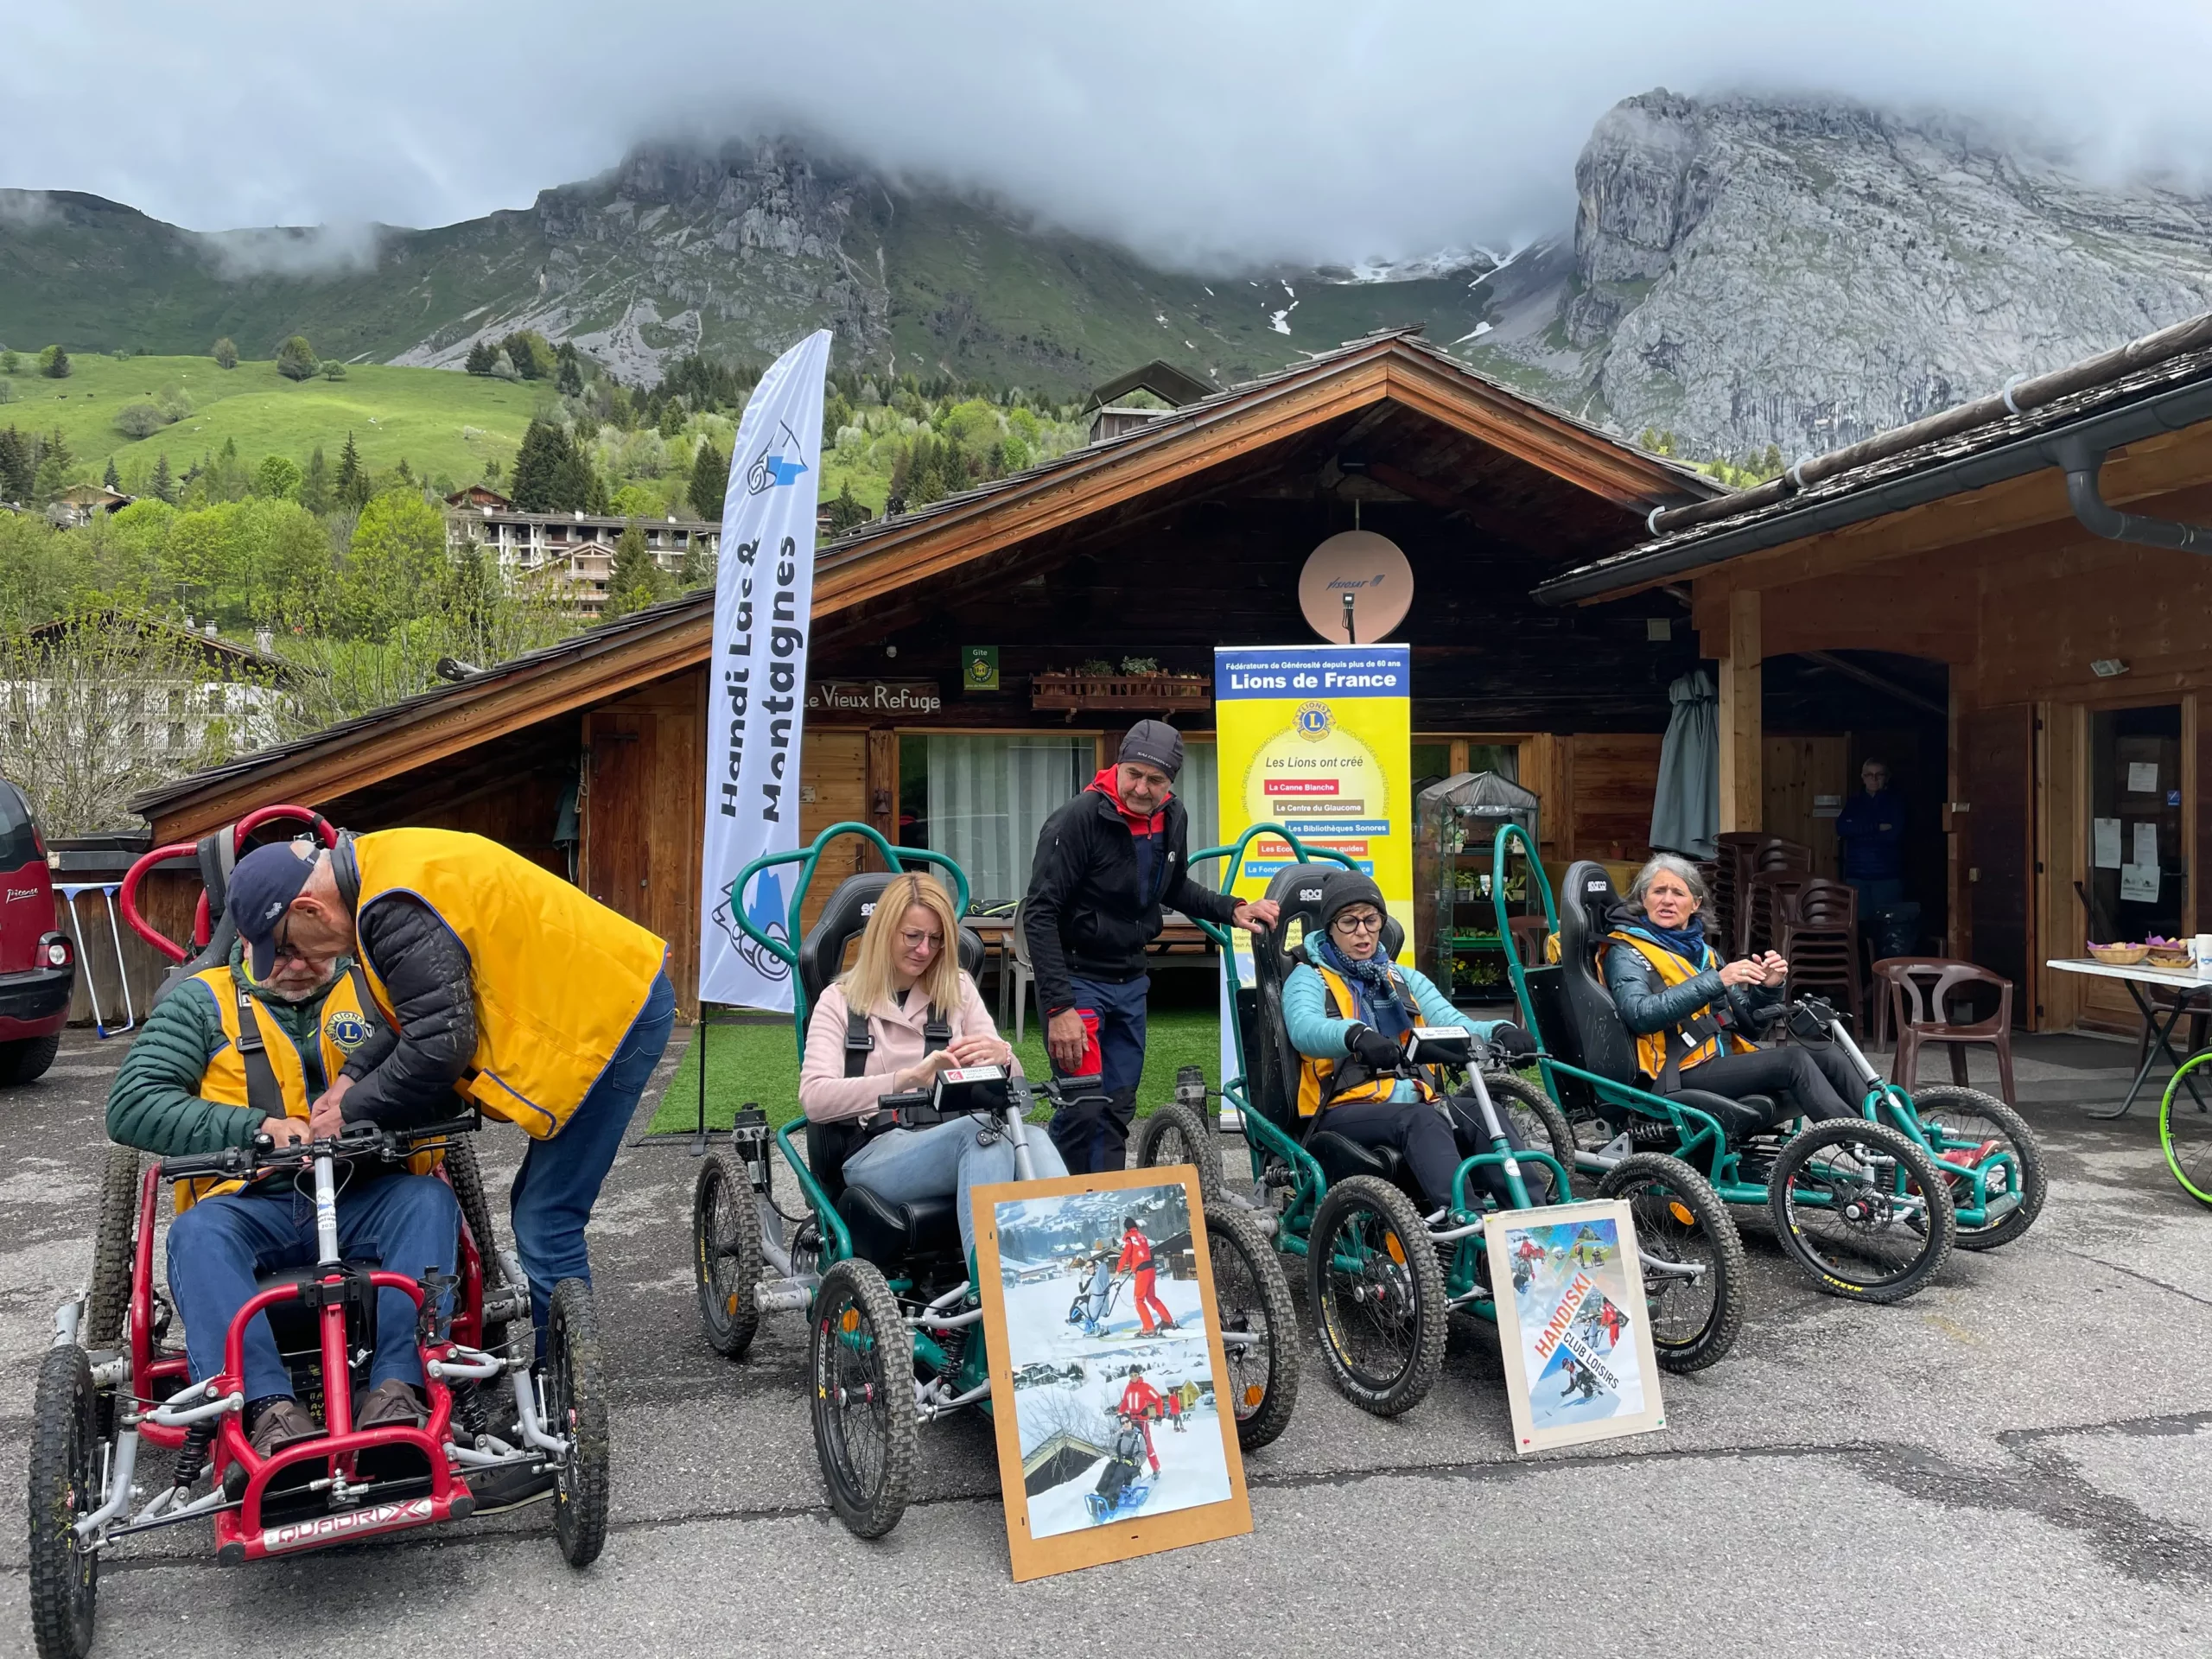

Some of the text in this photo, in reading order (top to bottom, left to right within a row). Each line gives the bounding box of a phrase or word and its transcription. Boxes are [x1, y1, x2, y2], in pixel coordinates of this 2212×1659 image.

[1281, 660, 1320, 669] Générosité
[1322, 660, 1347, 670] depuis
[1348, 659, 1364, 669] plus
[1366, 659, 1376, 668] de
[1376, 659, 1386, 668] 60
[721, 668, 750, 817] Handi
[737, 536, 760, 567] &
[762, 536, 804, 823] Montagnes
[1230, 671, 1397, 690] Lions de France
[821, 685, 870, 708] Vieux
[1300, 702, 1327, 711] LIONS
[1309, 713, 1321, 728] L
[1251, 725, 1292, 760] PROMOUVOIR
[1336, 724, 1378, 760] ENCOURAGER
[1265, 755, 1363, 768] Les Lions ont créé
[1304, 783, 1335, 791] Blanche
[1303, 823, 1354, 833] Bibliothèques
[1355, 823, 1387, 832] Sonores
[334, 1012, 364, 1025] LIONS
[343, 1023, 359, 1039] L
[1535, 1272, 1592, 1359] HANDISKI
[1326, 1324, 1340, 1349] JUMBO
[1318, 1327, 1349, 1379] SMART
[1348, 1381, 1374, 1400] SAM
[1563, 1332, 1619, 1389] CLUB LOISIRS
